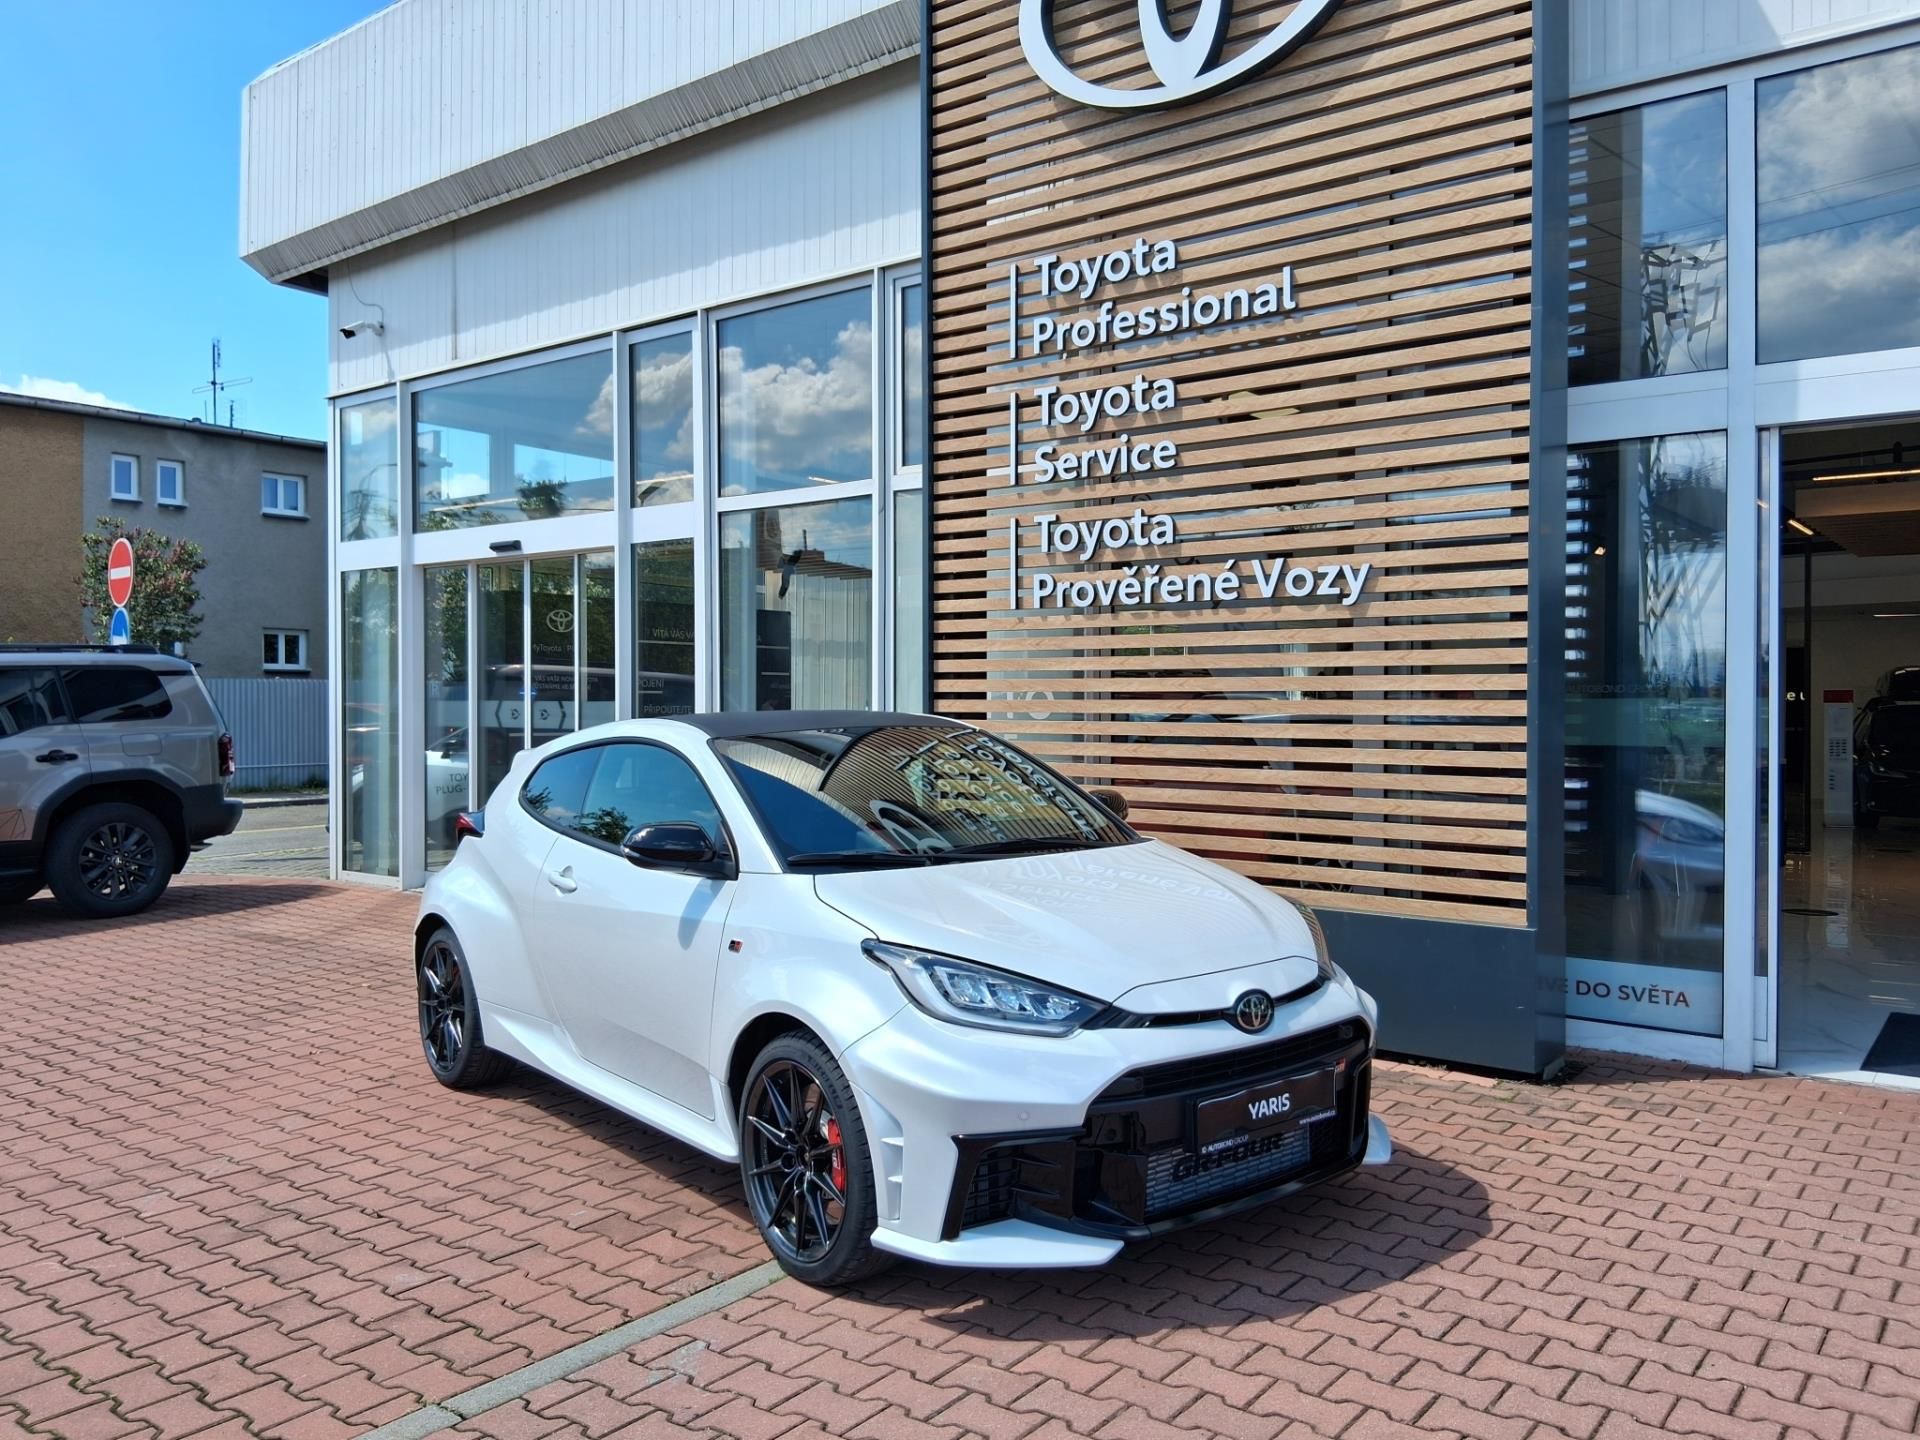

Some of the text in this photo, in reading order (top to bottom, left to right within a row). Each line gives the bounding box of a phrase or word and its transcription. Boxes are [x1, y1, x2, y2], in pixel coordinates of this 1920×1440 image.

[1034, 237, 1177, 300] Toyota
[1033, 265, 1296, 356] Professional
[1034, 374, 1177, 432] Toyota
[1034, 434, 1177, 484] Service
[1034, 508, 1176, 561] Toyota
[1033, 557, 1371, 609] Prověřené Vozy
[1576, 980, 1611, 998] DO
[1618, 984, 1690, 1009] SVĚTA
[1248, 1092, 1290, 1120] YARIS
